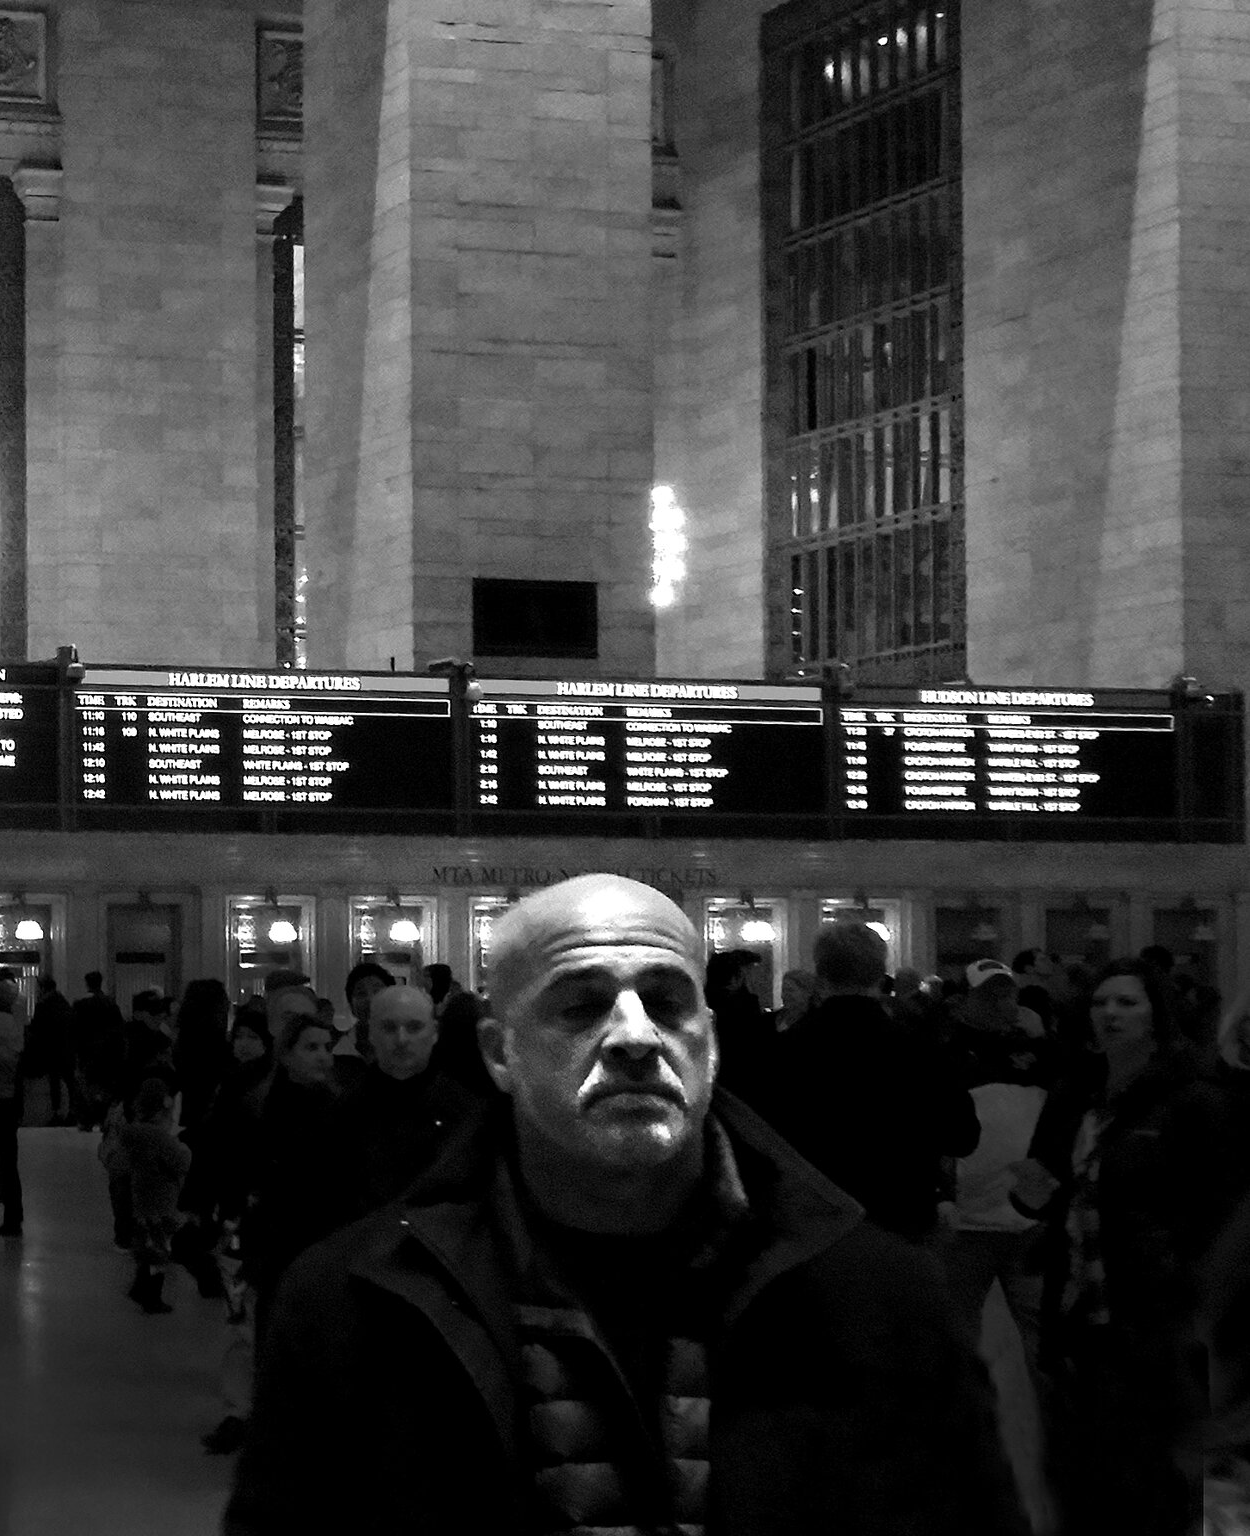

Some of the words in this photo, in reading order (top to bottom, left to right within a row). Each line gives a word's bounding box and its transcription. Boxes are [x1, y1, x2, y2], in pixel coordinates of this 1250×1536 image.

[168, 673, 228, 688] HARLEM
[235, 676, 267, 689] LINE
[269, 677, 361, 690] DEPARTURES
[556, 682, 614, 696] HARLEM
[616, 684, 649, 697] LINE
[651, 685, 737, 699] DEPARTURES
[78, 695, 105, 706] TIME
[147, 697, 217, 708] DESTINATION
[243, 699, 290, 709] REMARKS
[921, 690, 977, 703] HUDSON
[979, 692, 1010, 704] LINE
[1012, 693, 1093, 706] DEPARTURES
[537, 705, 603, 715] DESTINATION
[83, 711, 104, 720] 11:10
[122, 712, 137, 720] 110
[148, 712, 201, 722] SOUTHEAST
[243, 715, 299, 724] CONNECTION
[301, 716, 313, 724] TO
[538, 721, 587, 730] SOUTHEAST
[159, 728, 187, 737] WHITE
[189, 729, 219, 738] PLAINS
[244, 730, 284, 739] MELROSE
[292, 731, 307, 739] 1ST
[308, 731, 332, 740] STOP
[0, 740, 15, 750] TO
[159, 744, 187, 753] WHITE
[189, 745, 219, 753] PLAINS
[244, 745, 285, 754] MELROSE
[292, 746, 307, 754] 1ST
[308, 746, 331, 755] STOP
[83, 758, 105, 767] 12:10
[149, 759, 201, 769] SOUTHEAST
[243, 761, 271, 769] WHITE
[272, 762, 302, 770] PLAINS
[326, 763, 349, 771] STOP
[538, 766, 588, 775] SOUTHEAST
[160, 775, 188, 784] WHITE
[190, 776, 220, 784] PLAINS
[244, 776, 285, 785] MELROSE
[292, 777, 307, 786] 1ST
[308, 778, 332, 786] STOP
[160, 791, 188, 799] WHITE
[190, 792, 220, 800] PLAINS
[244, 792, 285, 800] MELROSE
[292, 793, 307, 801] 1ST
[309, 793, 332, 801] STOP
[432, 866, 473, 883] MTA
[638, 867, 718, 885] TICKETS
